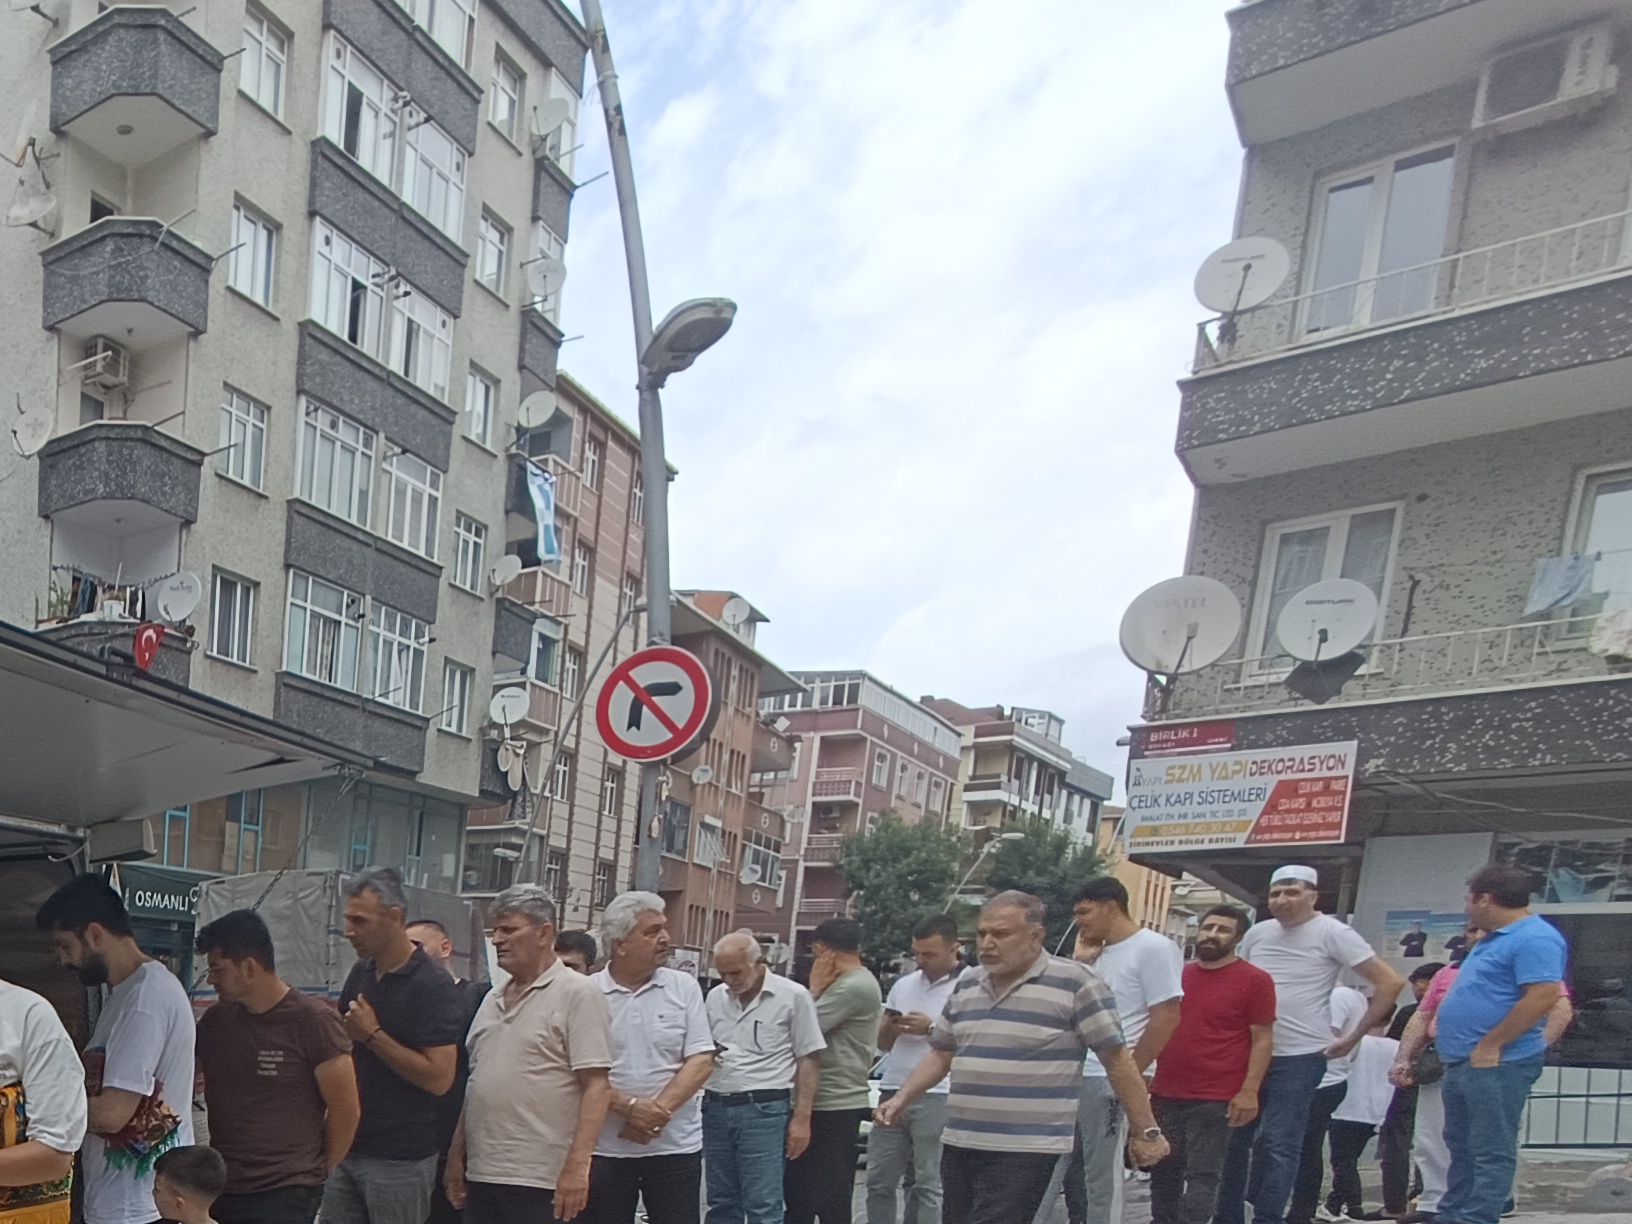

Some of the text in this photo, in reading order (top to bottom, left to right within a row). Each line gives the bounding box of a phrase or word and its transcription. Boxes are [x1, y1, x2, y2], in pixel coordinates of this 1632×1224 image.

[1164, 763, 1202, 785] SZM
[1209, 760, 1249, 781] YAPI
[1249, 753, 1347, 777] DEKORASYON
[1129, 782, 1268, 812] ÇELİK KAPI SİSTEMLERİ
[135, 890, 188, 911] OSMANLI
